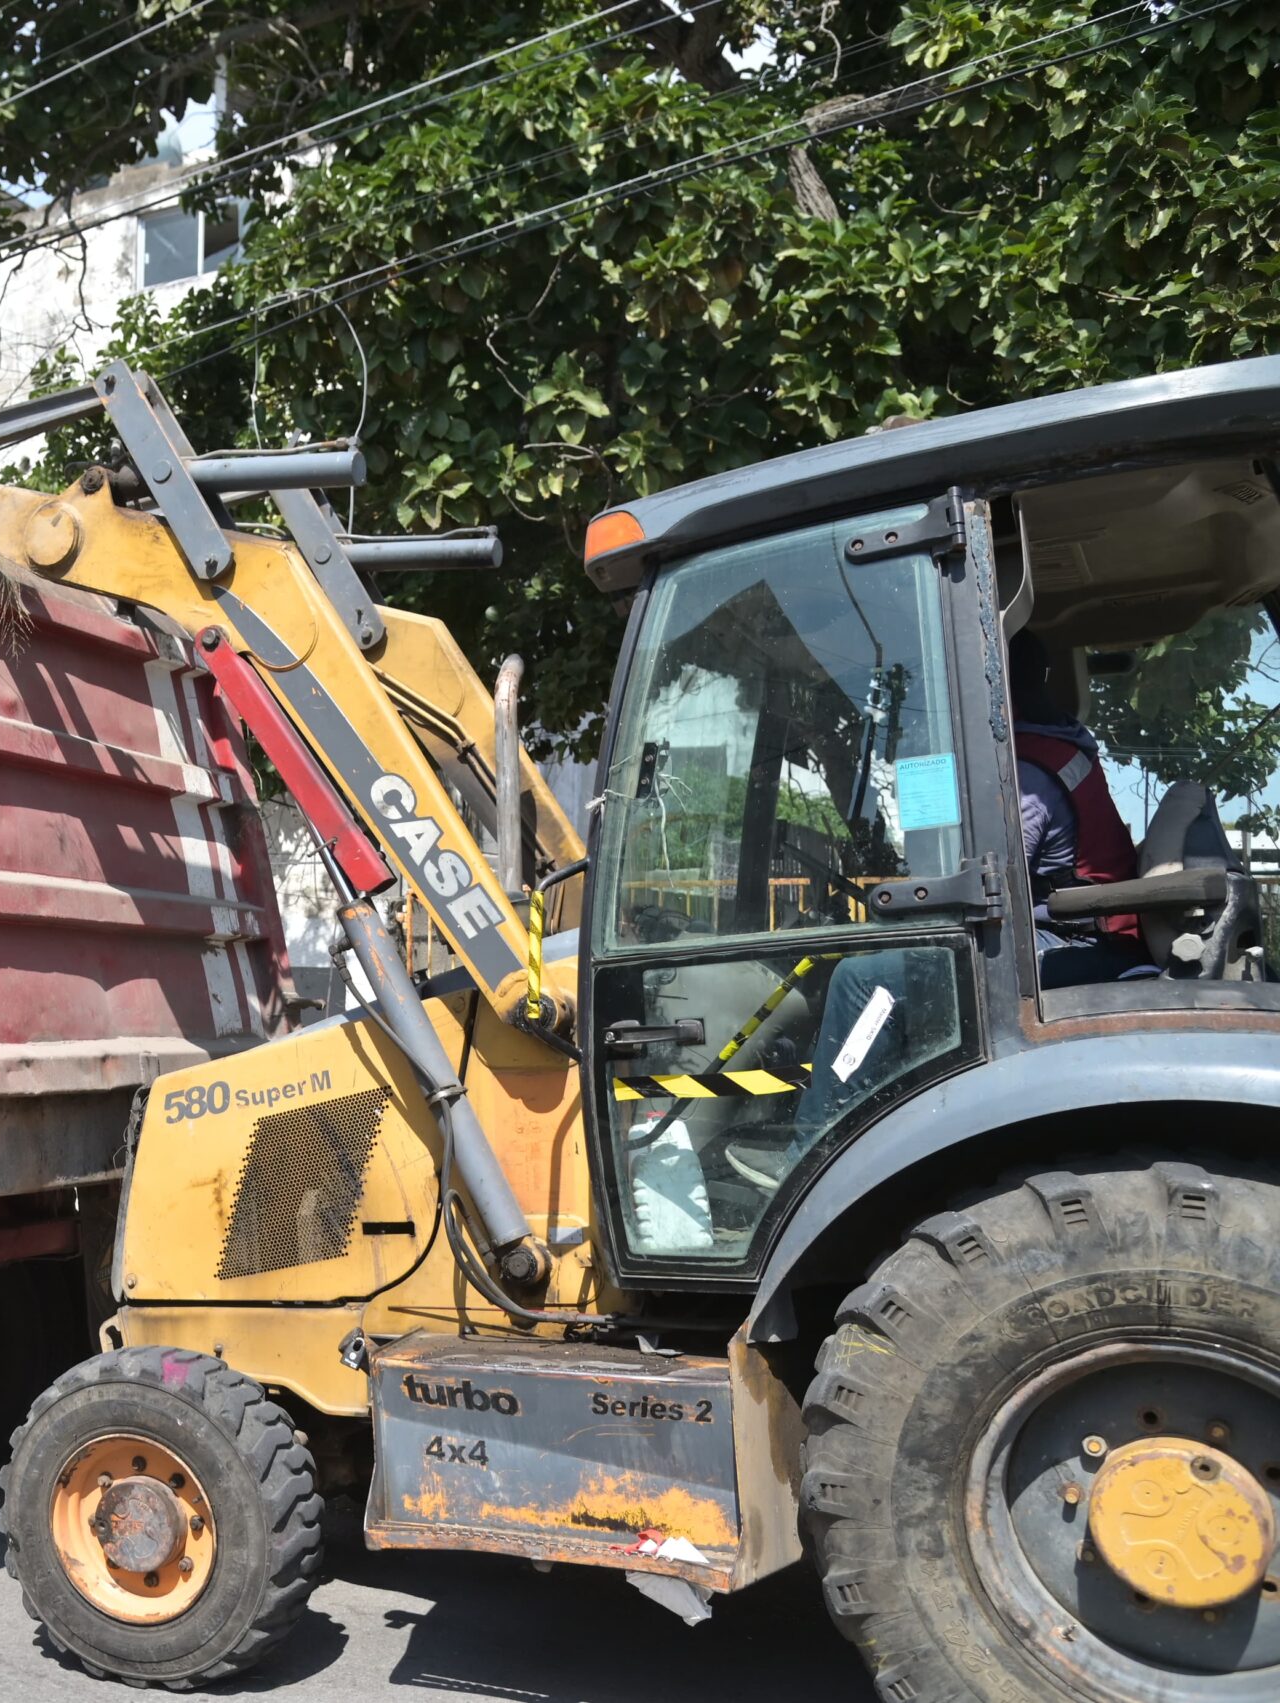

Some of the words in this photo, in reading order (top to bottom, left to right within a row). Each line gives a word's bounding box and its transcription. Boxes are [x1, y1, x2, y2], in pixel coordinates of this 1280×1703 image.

[370, 774, 505, 940] CASE
[163, 1080, 231, 1125] 580
[235, 1079, 307, 1108] Super
[402, 1373, 519, 1416] turbo
[591, 1392, 684, 1421] Series
[694, 1400, 713, 1423] 2
[425, 1435, 489, 1466] 4x4
